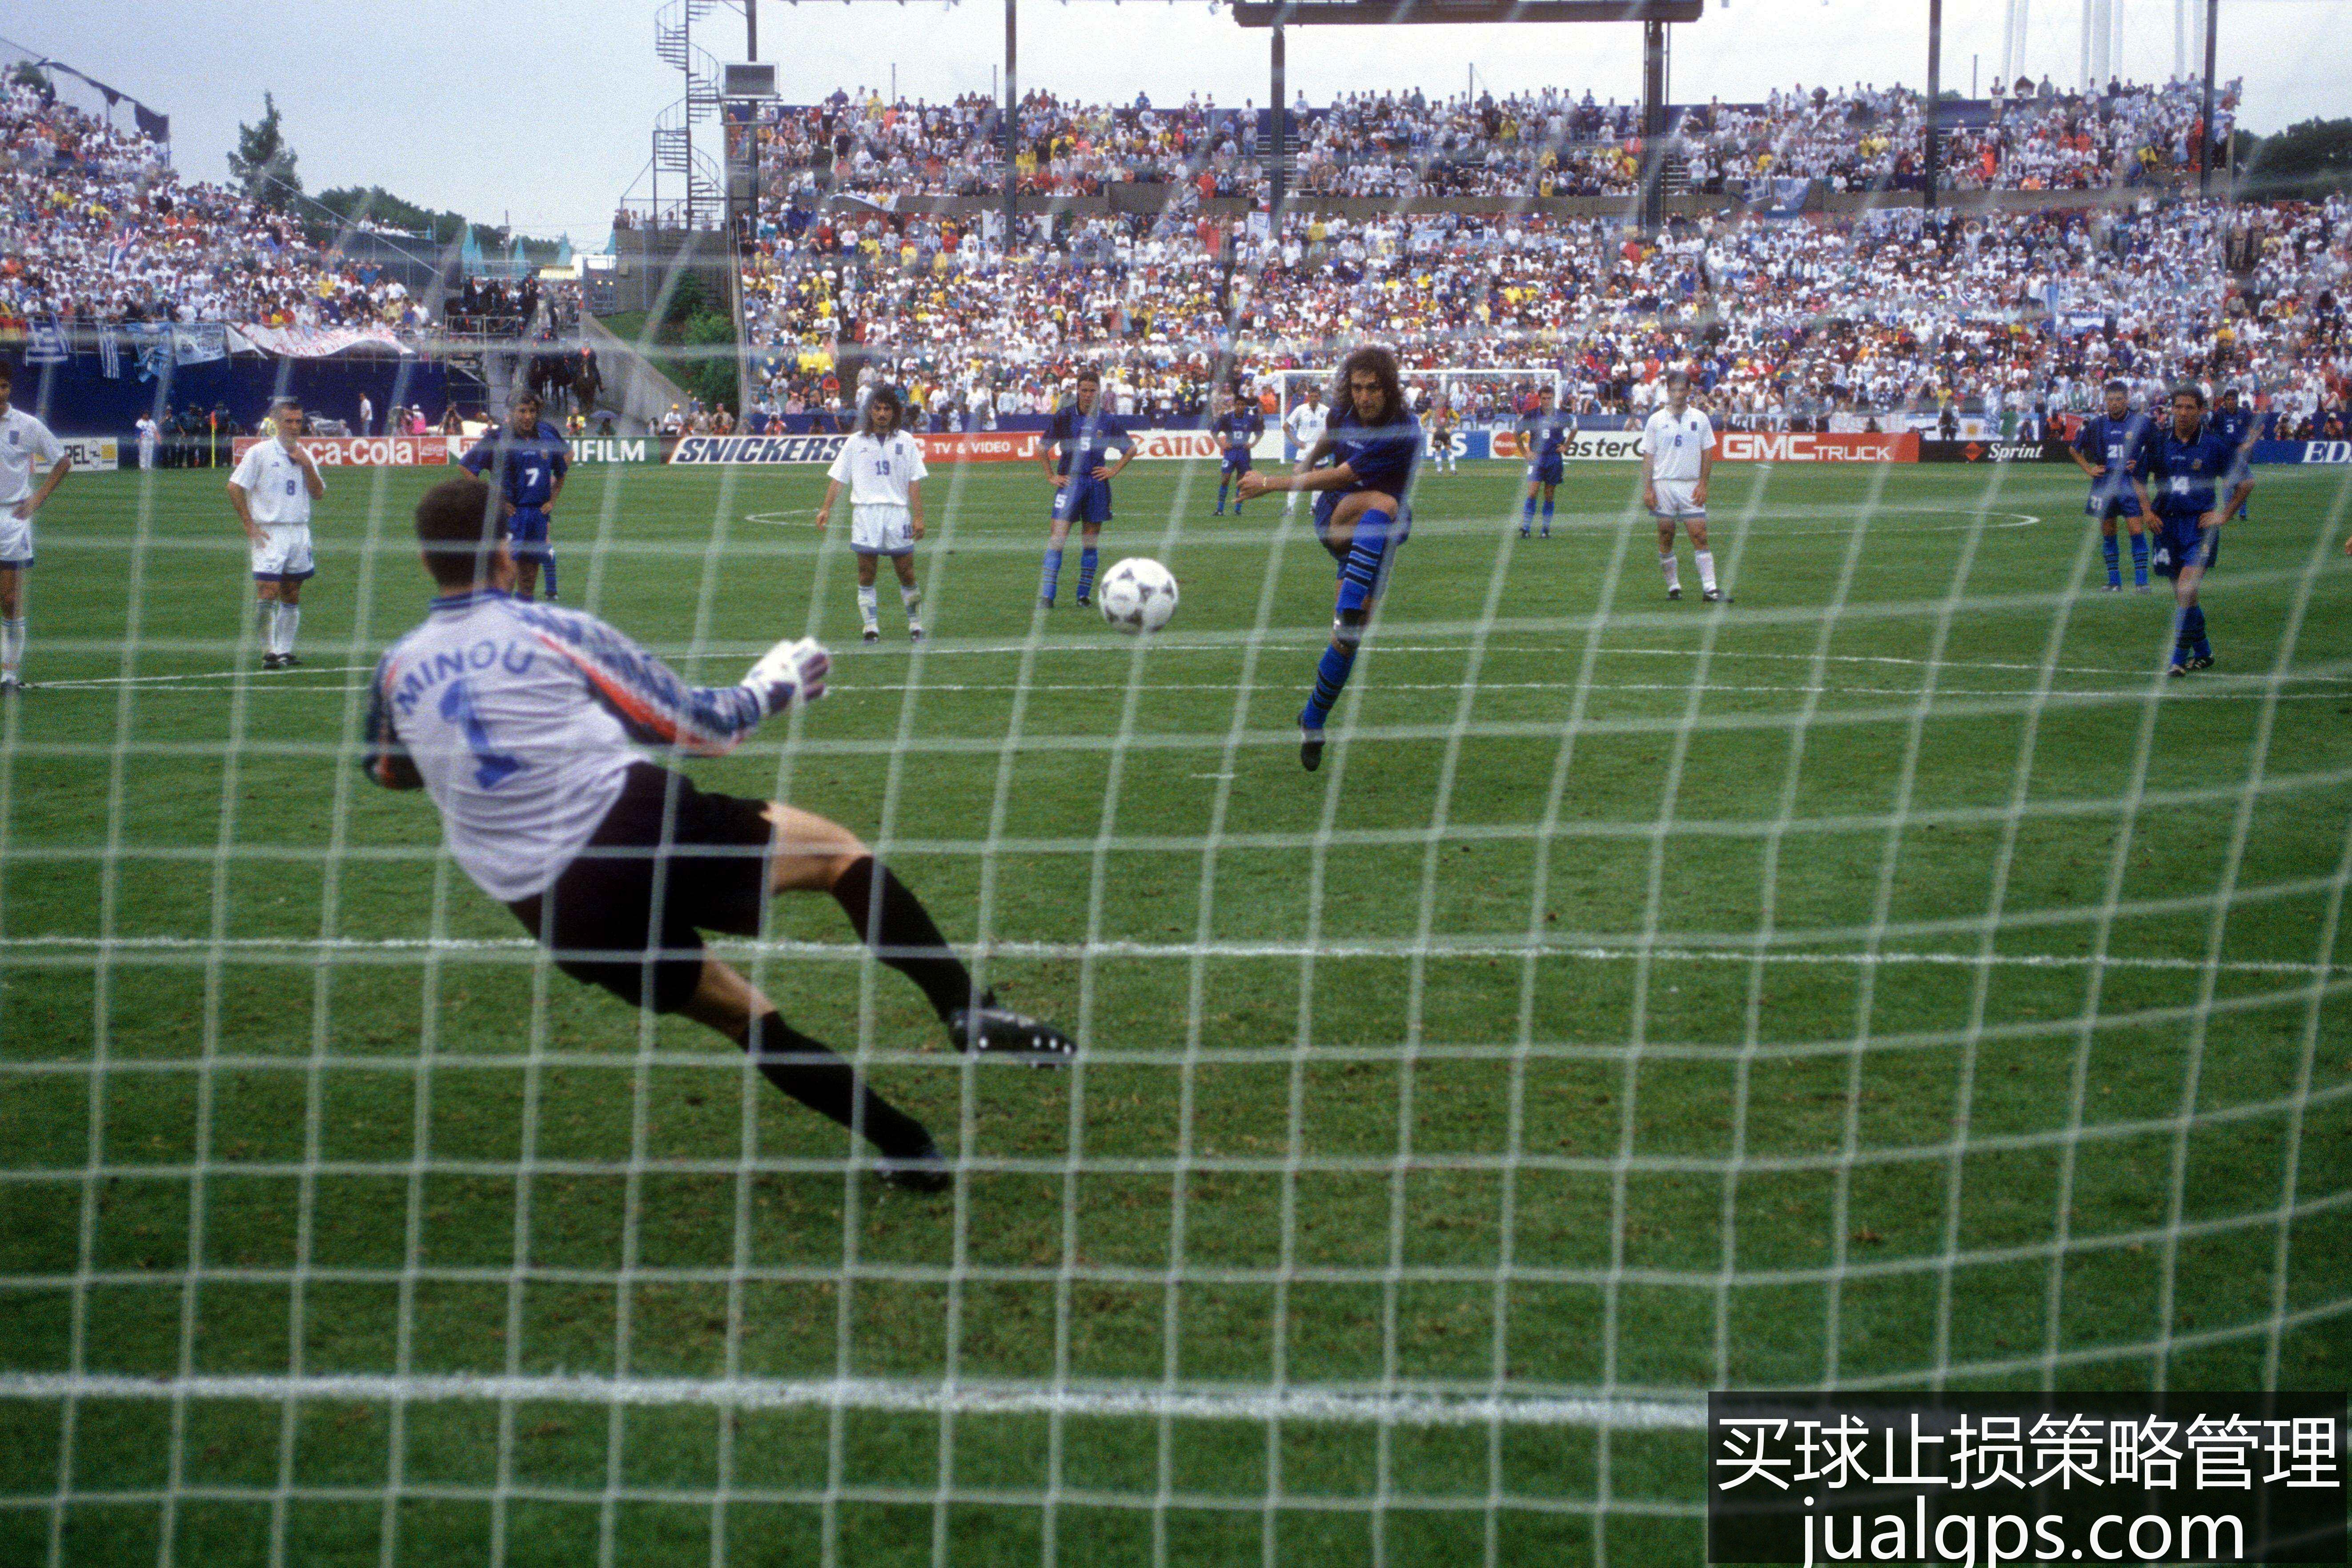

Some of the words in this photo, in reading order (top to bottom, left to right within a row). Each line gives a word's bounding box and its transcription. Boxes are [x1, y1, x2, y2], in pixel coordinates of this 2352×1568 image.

[64, 444, 90, 464] PEL
[307, 438, 413, 465] ca-Cola
[572, 440, 645, 462] IFILM
[676, 437, 849, 463] SNICKERS
[934, 442, 951, 454] TV
[971, 441, 1011, 453] VIDEO
[1722, 434, 1817, 460] GMC
[1814, 445, 1894, 461] TRUCK
[1988, 443, 2044, 462] Sprint
[2301, 440, 2352, 463] ED
[525, 467, 540, 487] 7
[875, 460, 890, 476] 19
[286, 479, 296, 496] 8
[395, 639, 534, 716] MINOU
